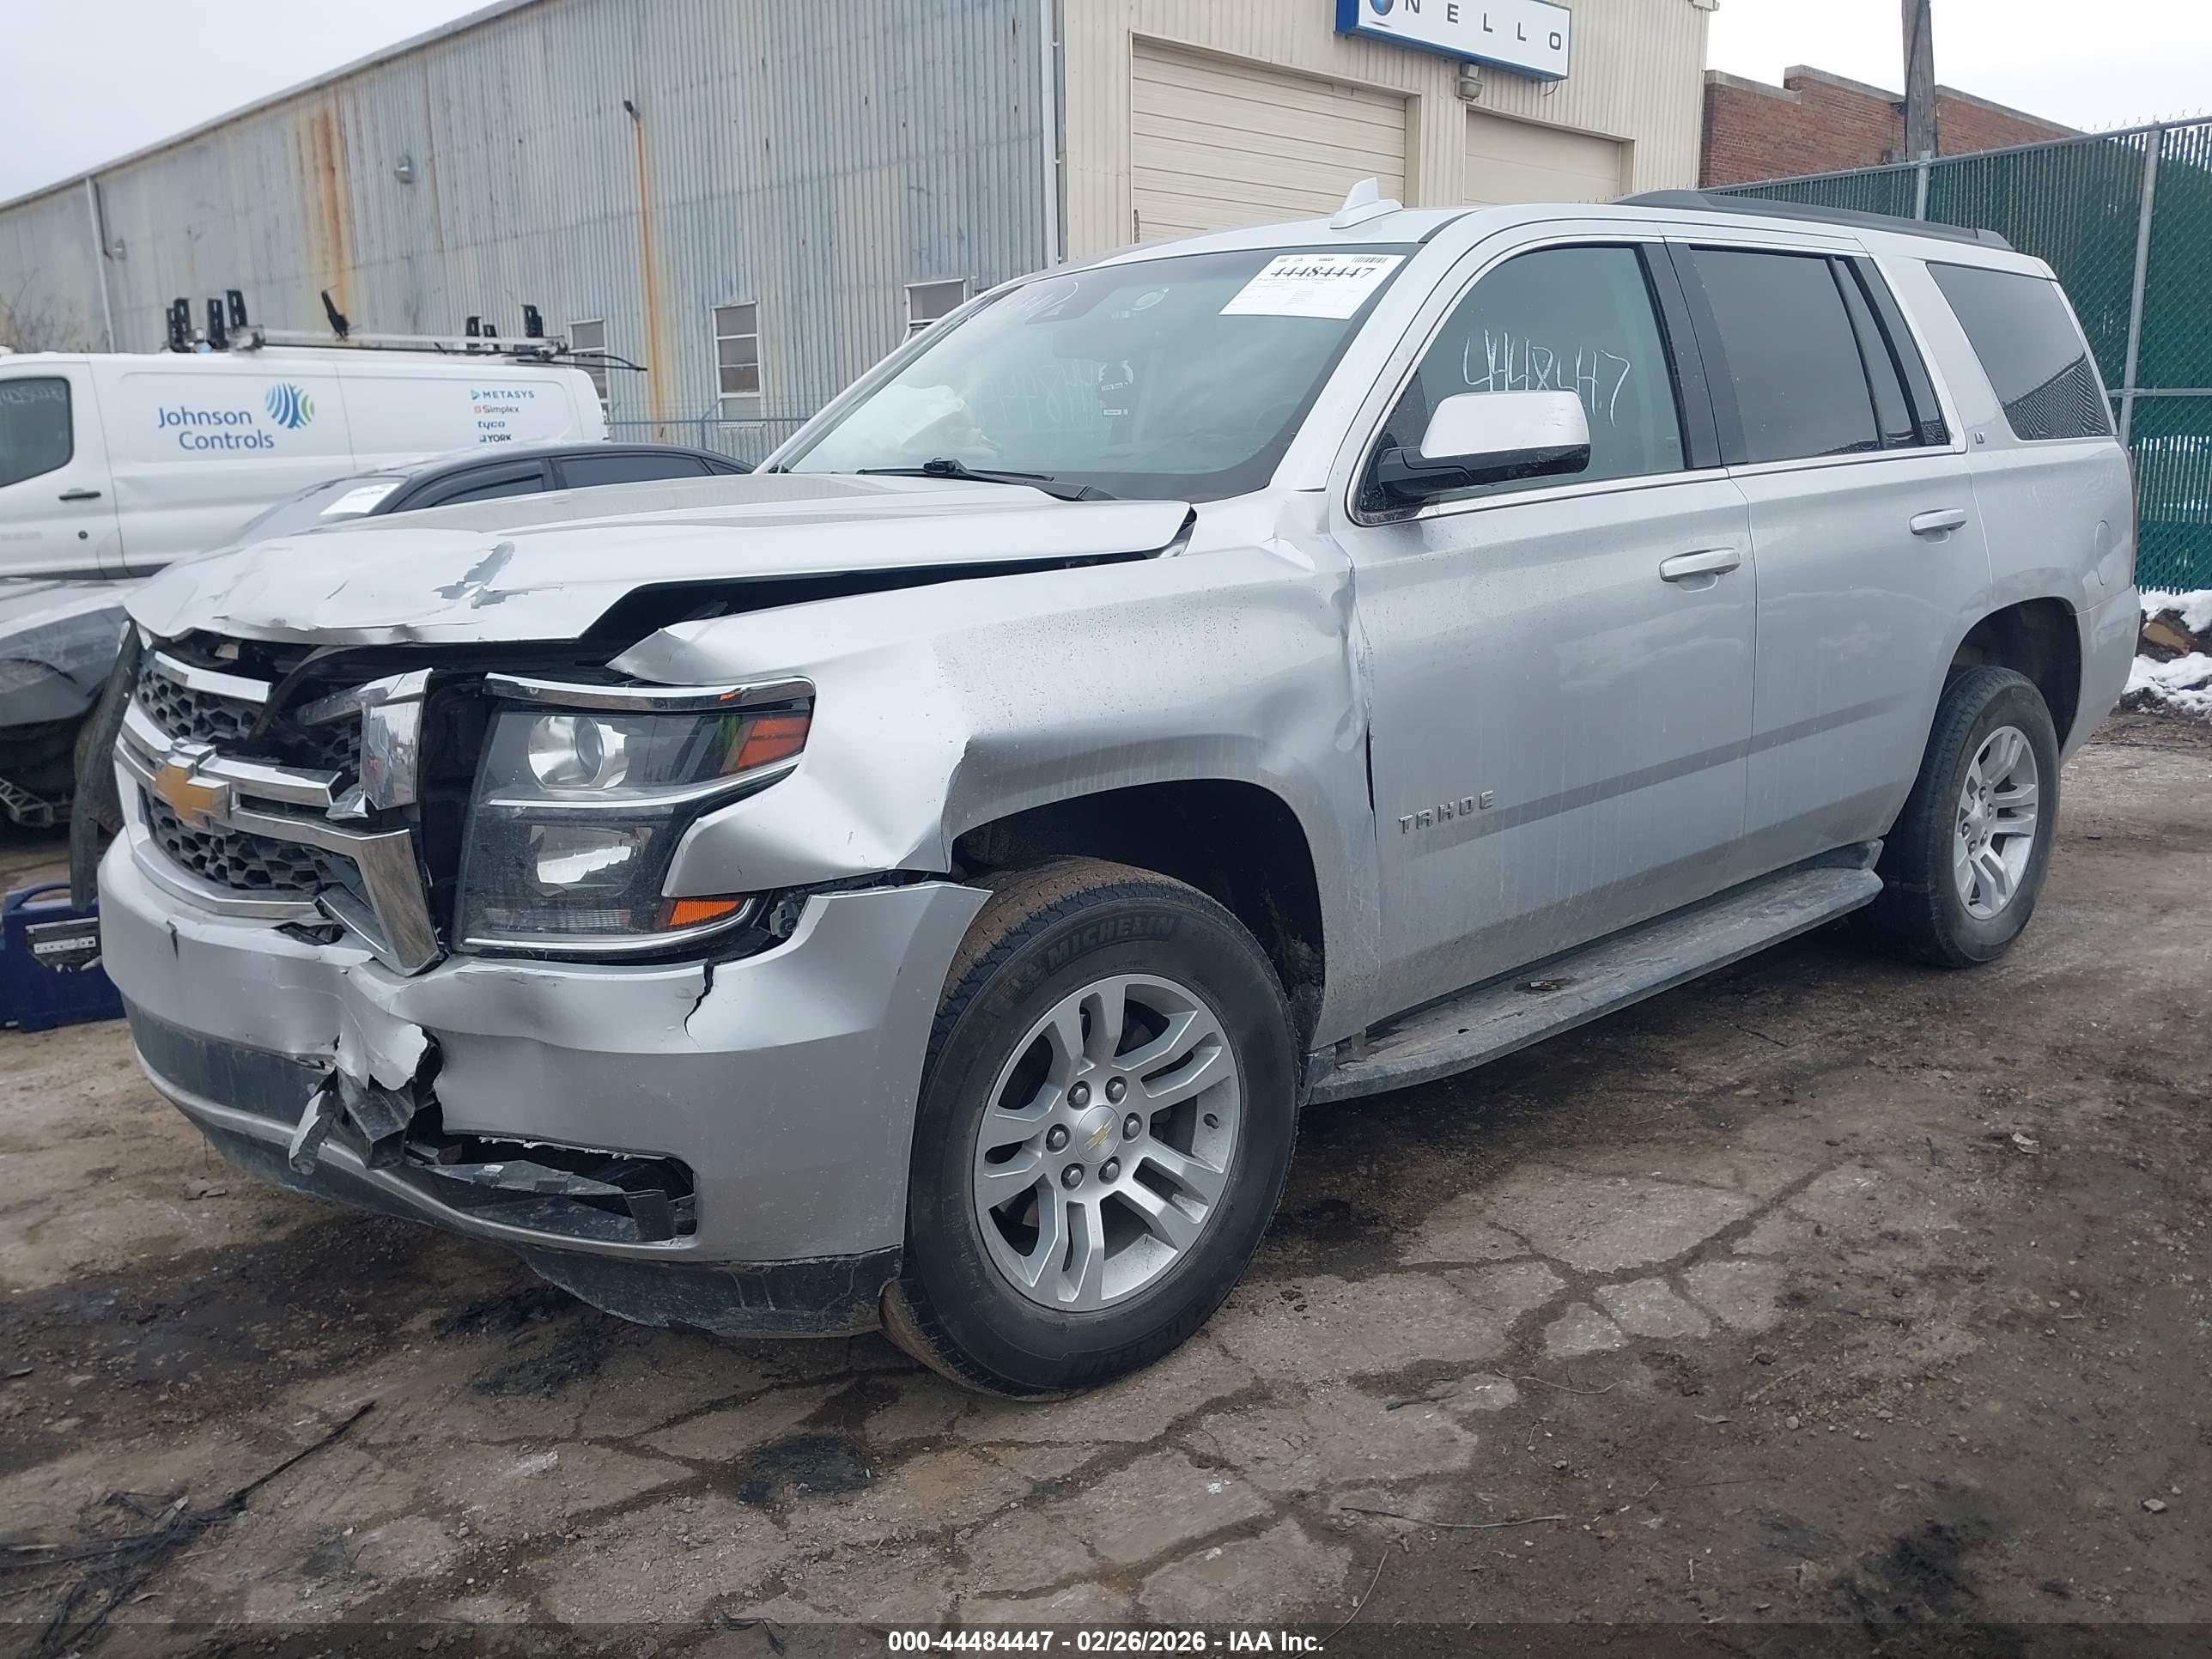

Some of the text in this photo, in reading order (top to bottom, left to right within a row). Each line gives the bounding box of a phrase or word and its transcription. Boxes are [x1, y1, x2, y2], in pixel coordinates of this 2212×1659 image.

[1271, 265, 1376, 279] 44484447
[483, 390, 535, 399] METASYS
[483, 404, 520, 414] Simplex
[158, 405, 252, 428] Johnson
[477, 420, 506, 430] tyco
[179, 428, 275, 450] Controls
[487, 434, 513, 443] YORK
[1398, 790, 1494, 835] TAHOE
[1047, 915, 1176, 969] MICHELIN
